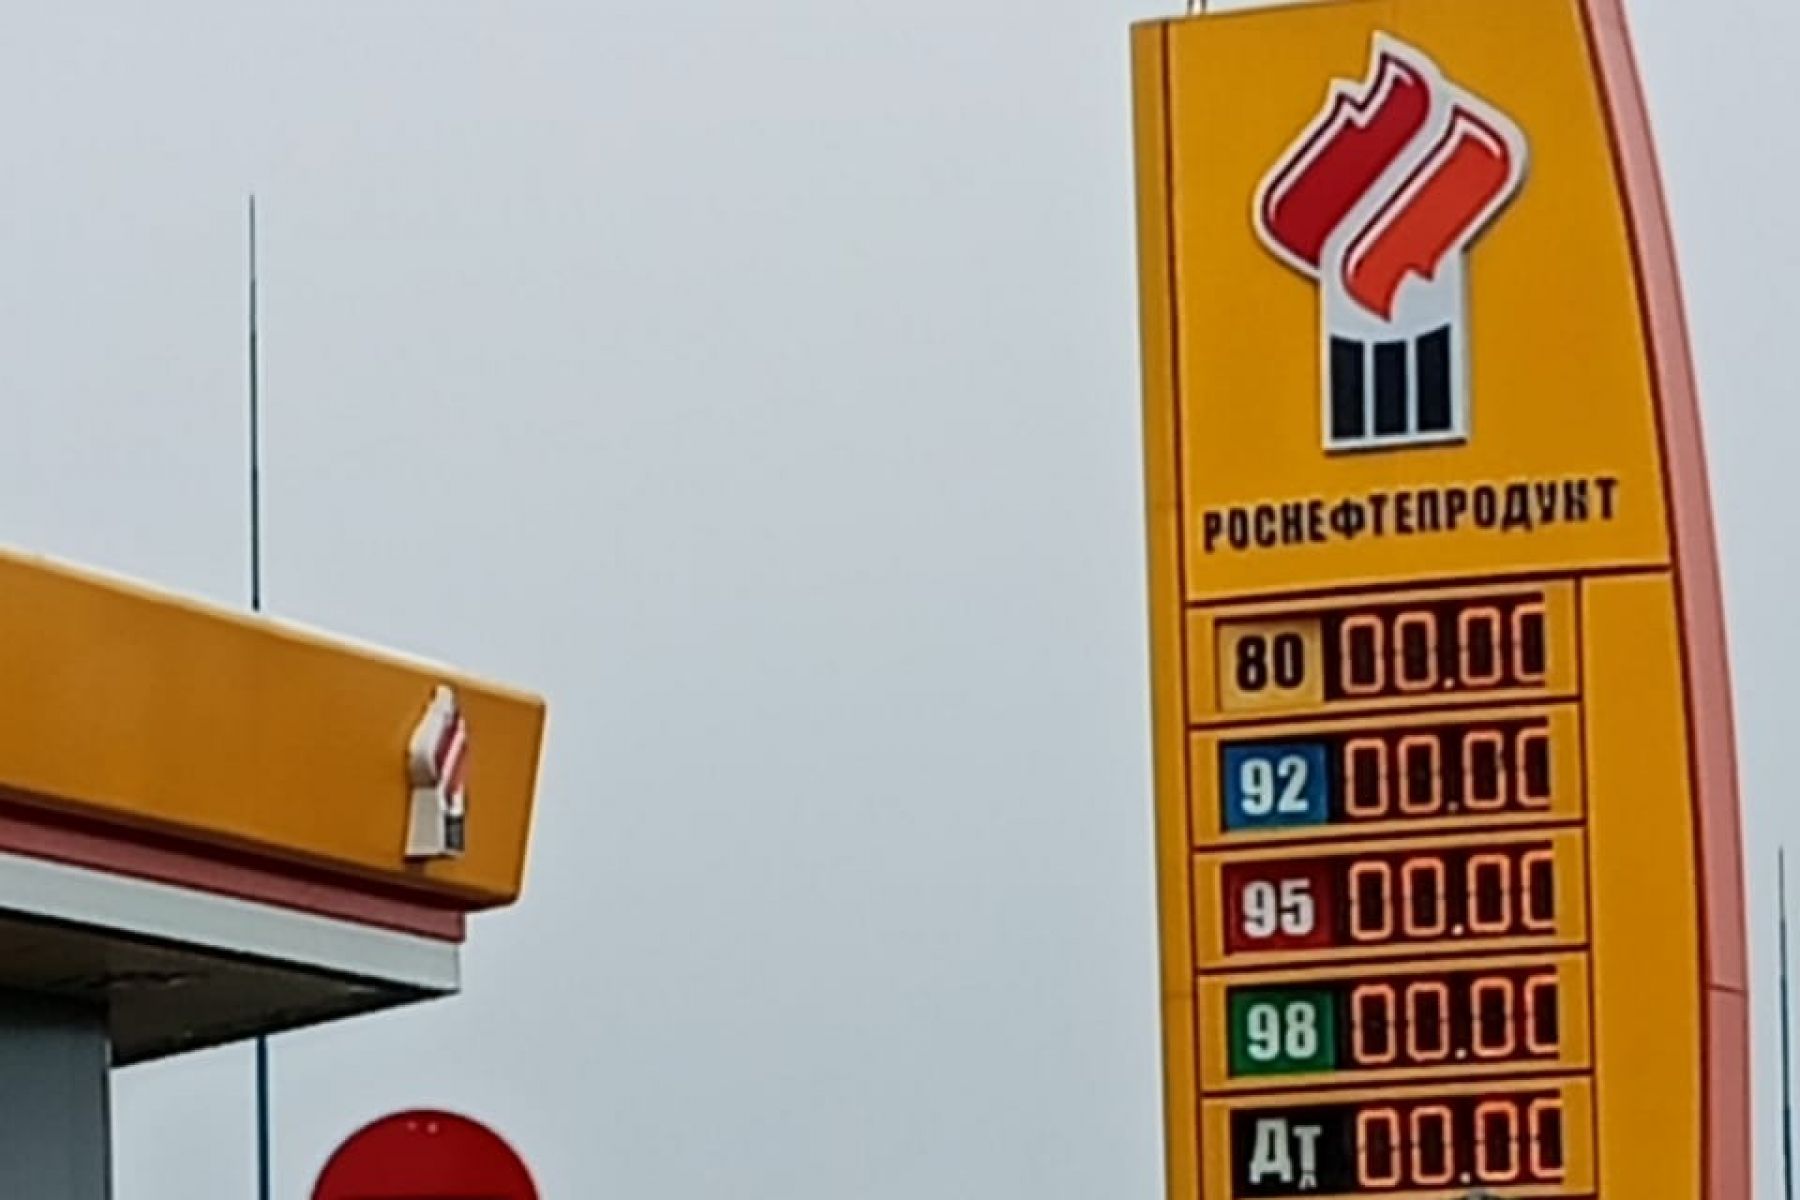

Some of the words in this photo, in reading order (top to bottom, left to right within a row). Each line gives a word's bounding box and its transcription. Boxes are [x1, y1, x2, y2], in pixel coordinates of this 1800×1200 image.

[1203, 476, 1618, 553] РОСНЕФТЕПРОДУКТ
[1235, 632, 1304, 692] 80
[1239, 755, 1308, 815] 92
[1242, 878, 1315, 938] 95
[1247, 1002, 1318, 1061] 98
